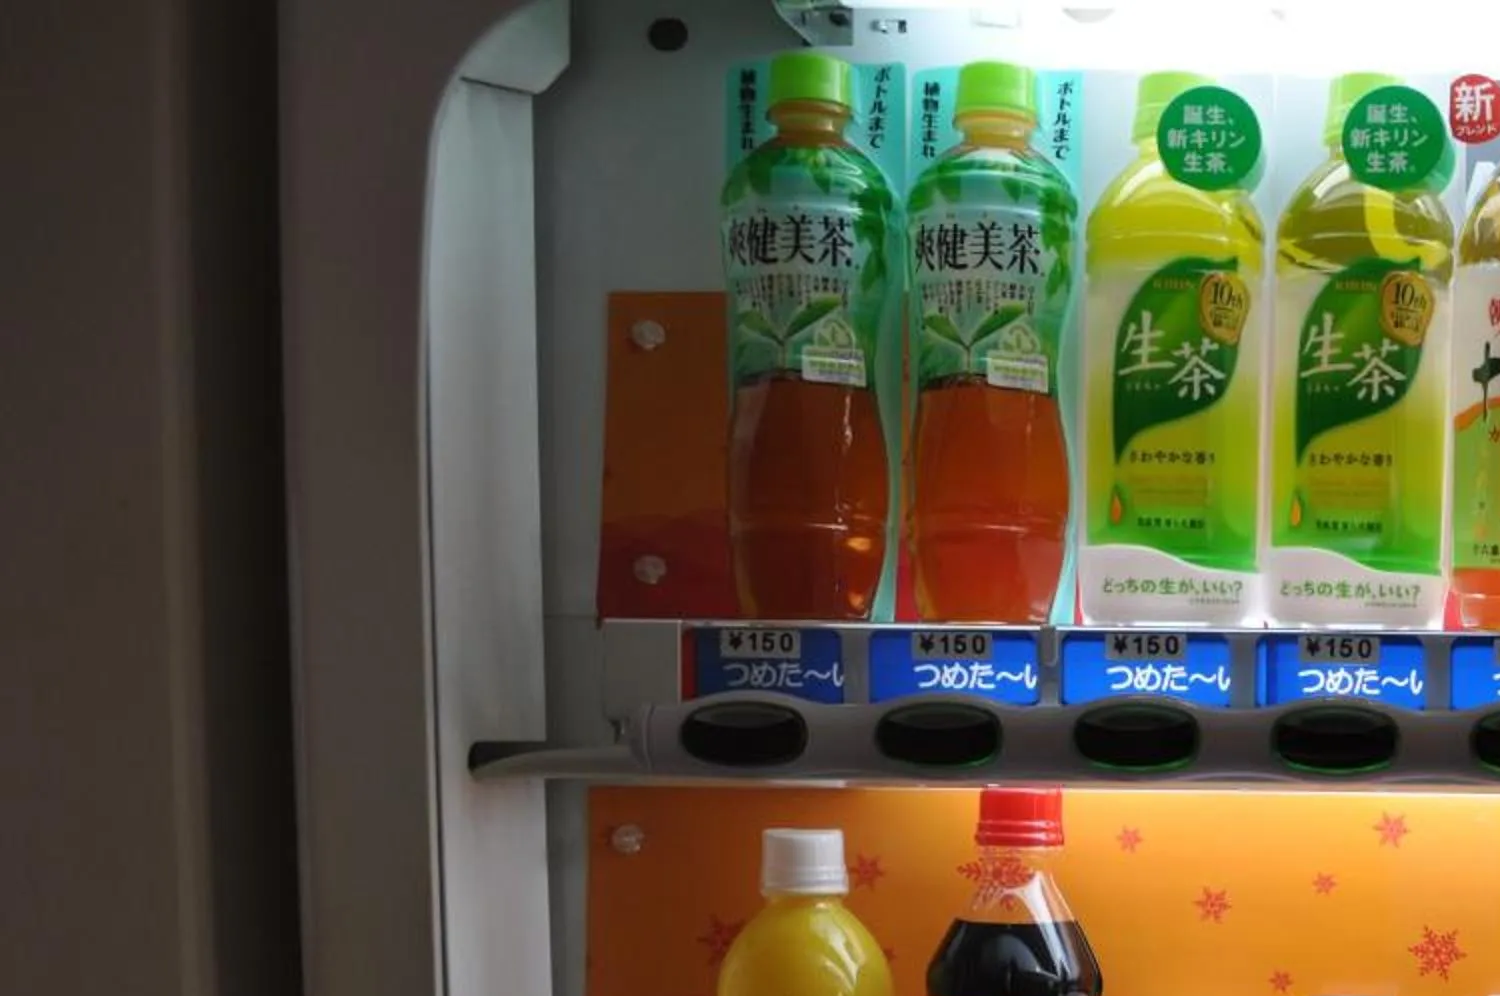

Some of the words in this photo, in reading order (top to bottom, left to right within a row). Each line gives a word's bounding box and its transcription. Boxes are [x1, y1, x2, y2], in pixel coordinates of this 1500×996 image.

[868, 66, 892, 148] ボトルまで
[1454, 79, 1496, 123] 新
[1055, 81, 1076, 160] ボトルまで
[1455, 125, 1498, 136] ブレンド
[1167, 128, 1246, 150] 新キリン
[1351, 128, 1430, 150] 新キリン
[729, 213, 856, 270] 爽健美茶
[914, 221, 1043, 276] 爽健美茶
[1117, 310, 1226, 400] 生茶
[1300, 311, 1407, 402] 生茶
[728, 633, 793, 654] ¥150
[918, 633, 987, 655] ¥150
[1113, 634, 1181, 656] ¥150
[1307, 637, 1373, 660] ¥150
